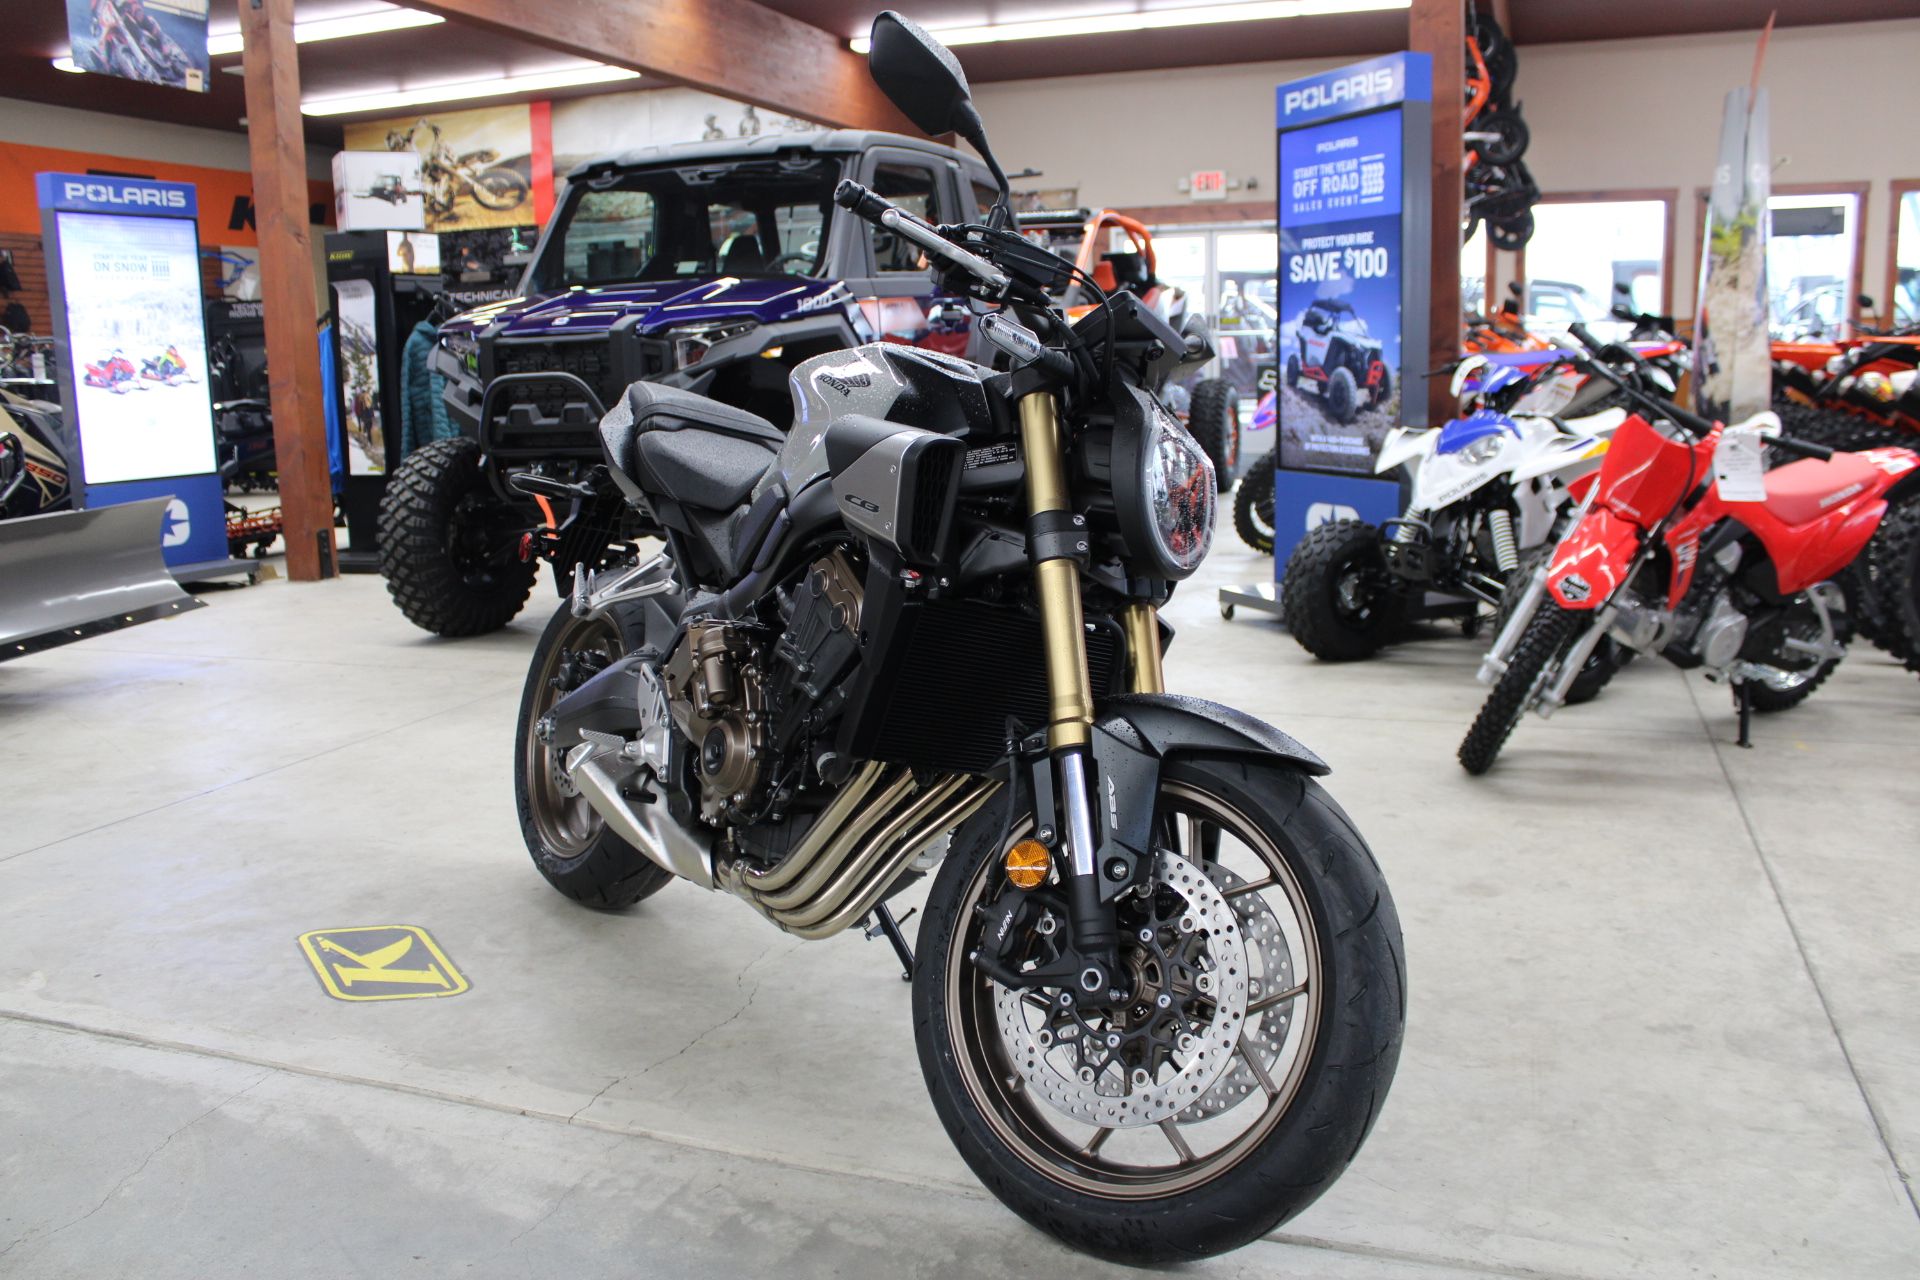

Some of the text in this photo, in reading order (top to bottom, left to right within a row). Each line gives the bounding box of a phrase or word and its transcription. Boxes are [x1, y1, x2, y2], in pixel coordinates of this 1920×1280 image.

[1284, 67, 1394, 116] POLARIS
[1316, 136, 1359, 154] POLARIS
[1196, 171, 1220, 192] EXIT
[1293, 158, 1358, 180] START THE YEAR
[64, 182, 187, 208] POLARIS
[1293, 171, 1359, 199] OFF ROAD
[1302, 230, 1375, 251] PROTECT YOUR RIDE
[94, 261, 148, 273] ON SNOW
[1289, 246, 1388, 284] SAVE $100
[231, 302, 263, 311] TECHNI
[1438, 472, 1488, 502] POLARIS
[844, 494, 880, 512] CB
[1107, 774, 1118, 830] ABS
[997, 909, 1013, 941] NISSIN
[315, 934, 452, 990] K
